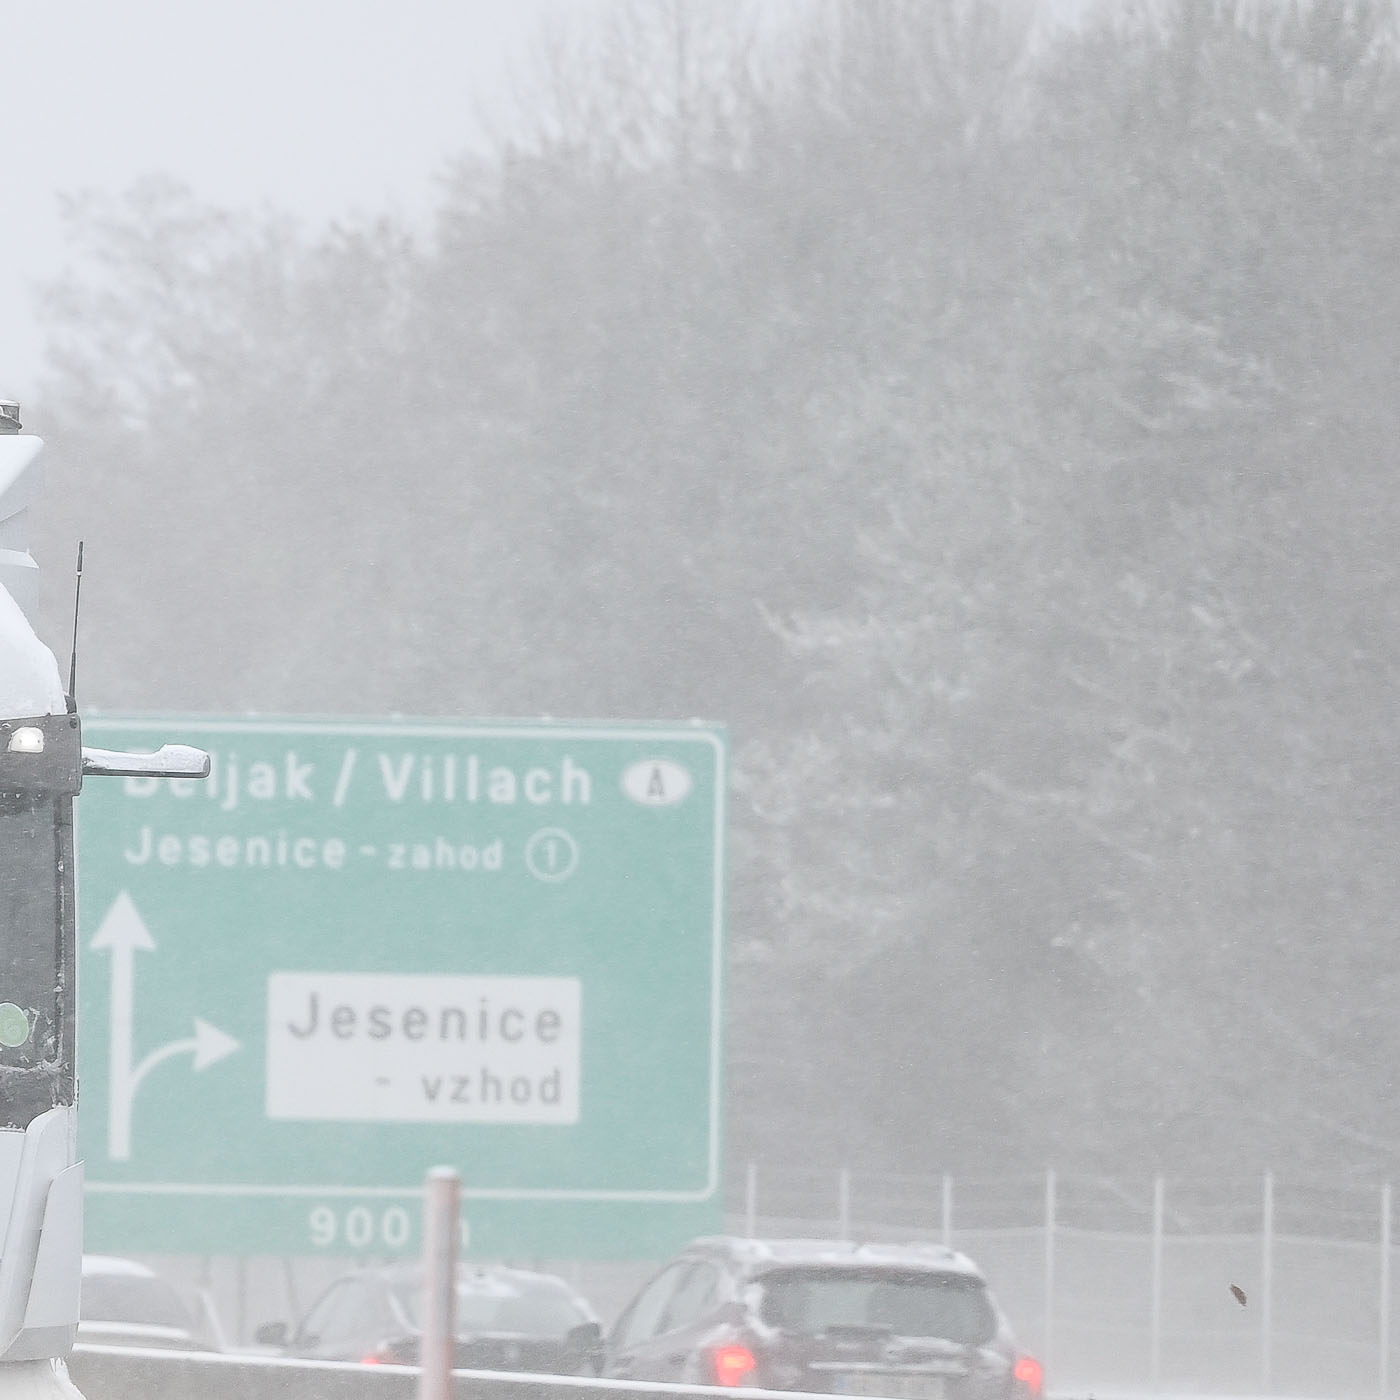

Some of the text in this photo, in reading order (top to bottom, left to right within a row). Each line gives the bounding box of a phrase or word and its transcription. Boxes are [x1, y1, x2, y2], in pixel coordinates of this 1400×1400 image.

[333, 749, 357, 808] /
[378, 753, 591, 805] Villach
[646, 766, 666, 798] A
[123, 825, 347, 869] Jesenice
[386, 835, 504, 871] zahod
[287, 991, 563, 1044] Jesenice
[421, 1065, 562, 1105] vzhod
[309, 1206, 411, 1247] 900
